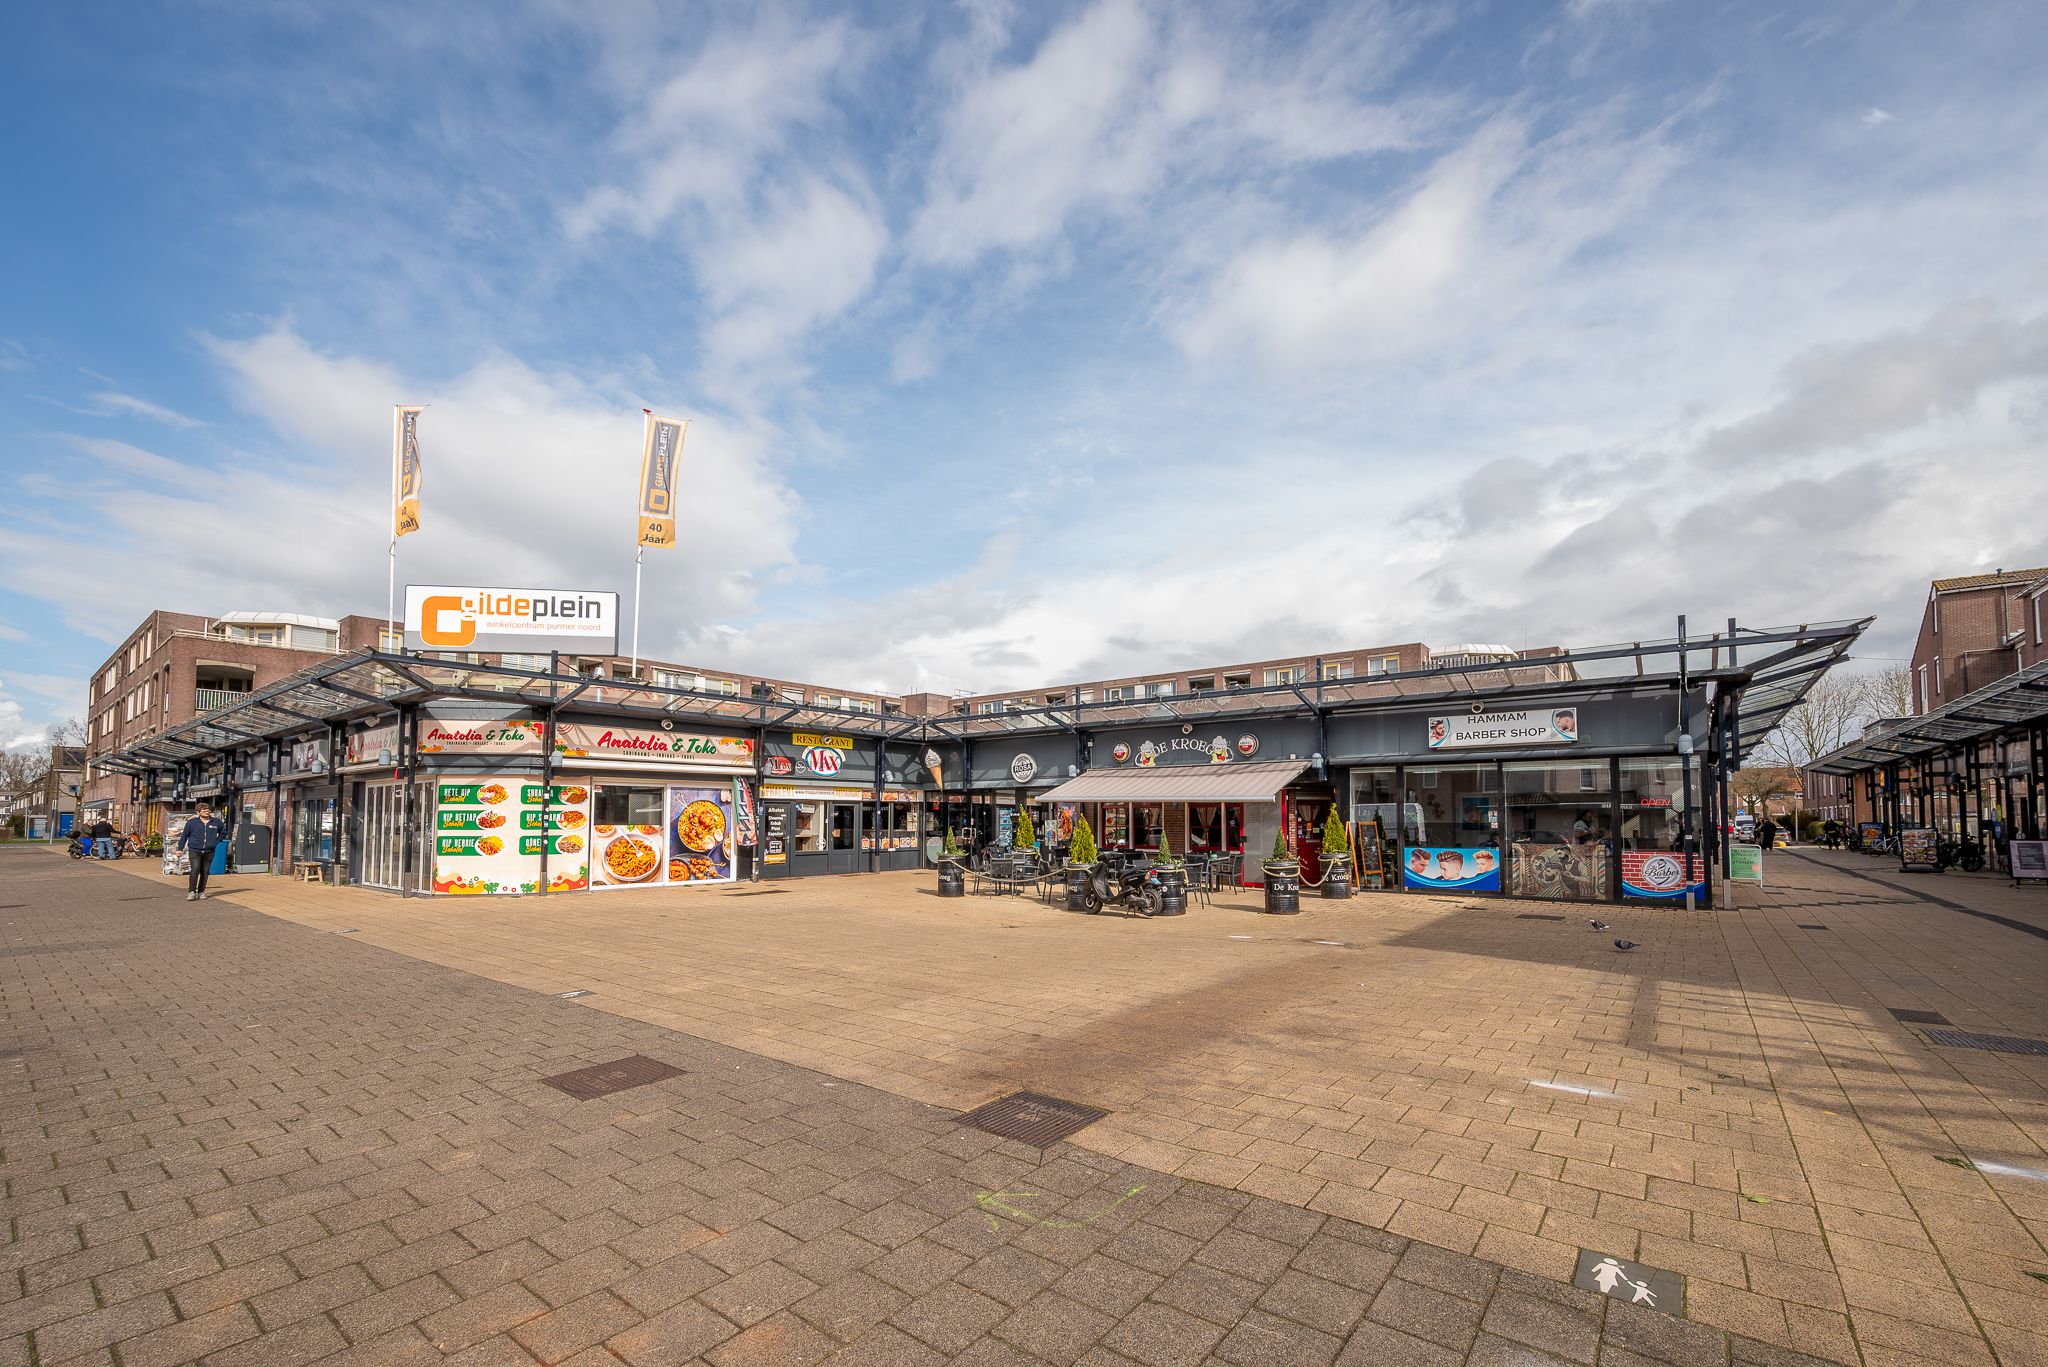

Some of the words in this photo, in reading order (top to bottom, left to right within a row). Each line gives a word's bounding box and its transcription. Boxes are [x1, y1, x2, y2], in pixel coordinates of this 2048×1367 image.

[655, 425, 669, 487] GILDEPLEIN
[649, 523, 662, 533] 40
[643, 533, 666, 545] Jaar
[486, 620, 545, 629] winkelcentrum
[547, 622, 576, 632] purmer
[578, 623, 601, 631] noord
[1467, 712, 1527, 724] HAMMAM
[427, 728, 482, 741] Anatolia
[485, 729, 496, 741] &
[498, 729, 524, 741] Toko
[1456, 729, 1506, 741] BARBER
[1510, 727, 1546, 738] SHOP
[597, 730, 668, 752] Anatolia
[672, 737, 684, 751] &
[687, 738, 717, 755] Toko
[796, 735, 850, 747] RESTARANT
[1153, 742, 1168, 757] DE
[1171, 738, 1215, 755] KROEG
[809, 749, 839, 772] MAX
[1014, 763, 1032, 773] ROSA
[1640, 798, 1671, 806] OPEN
[1644, 867, 1680, 878] Barber
